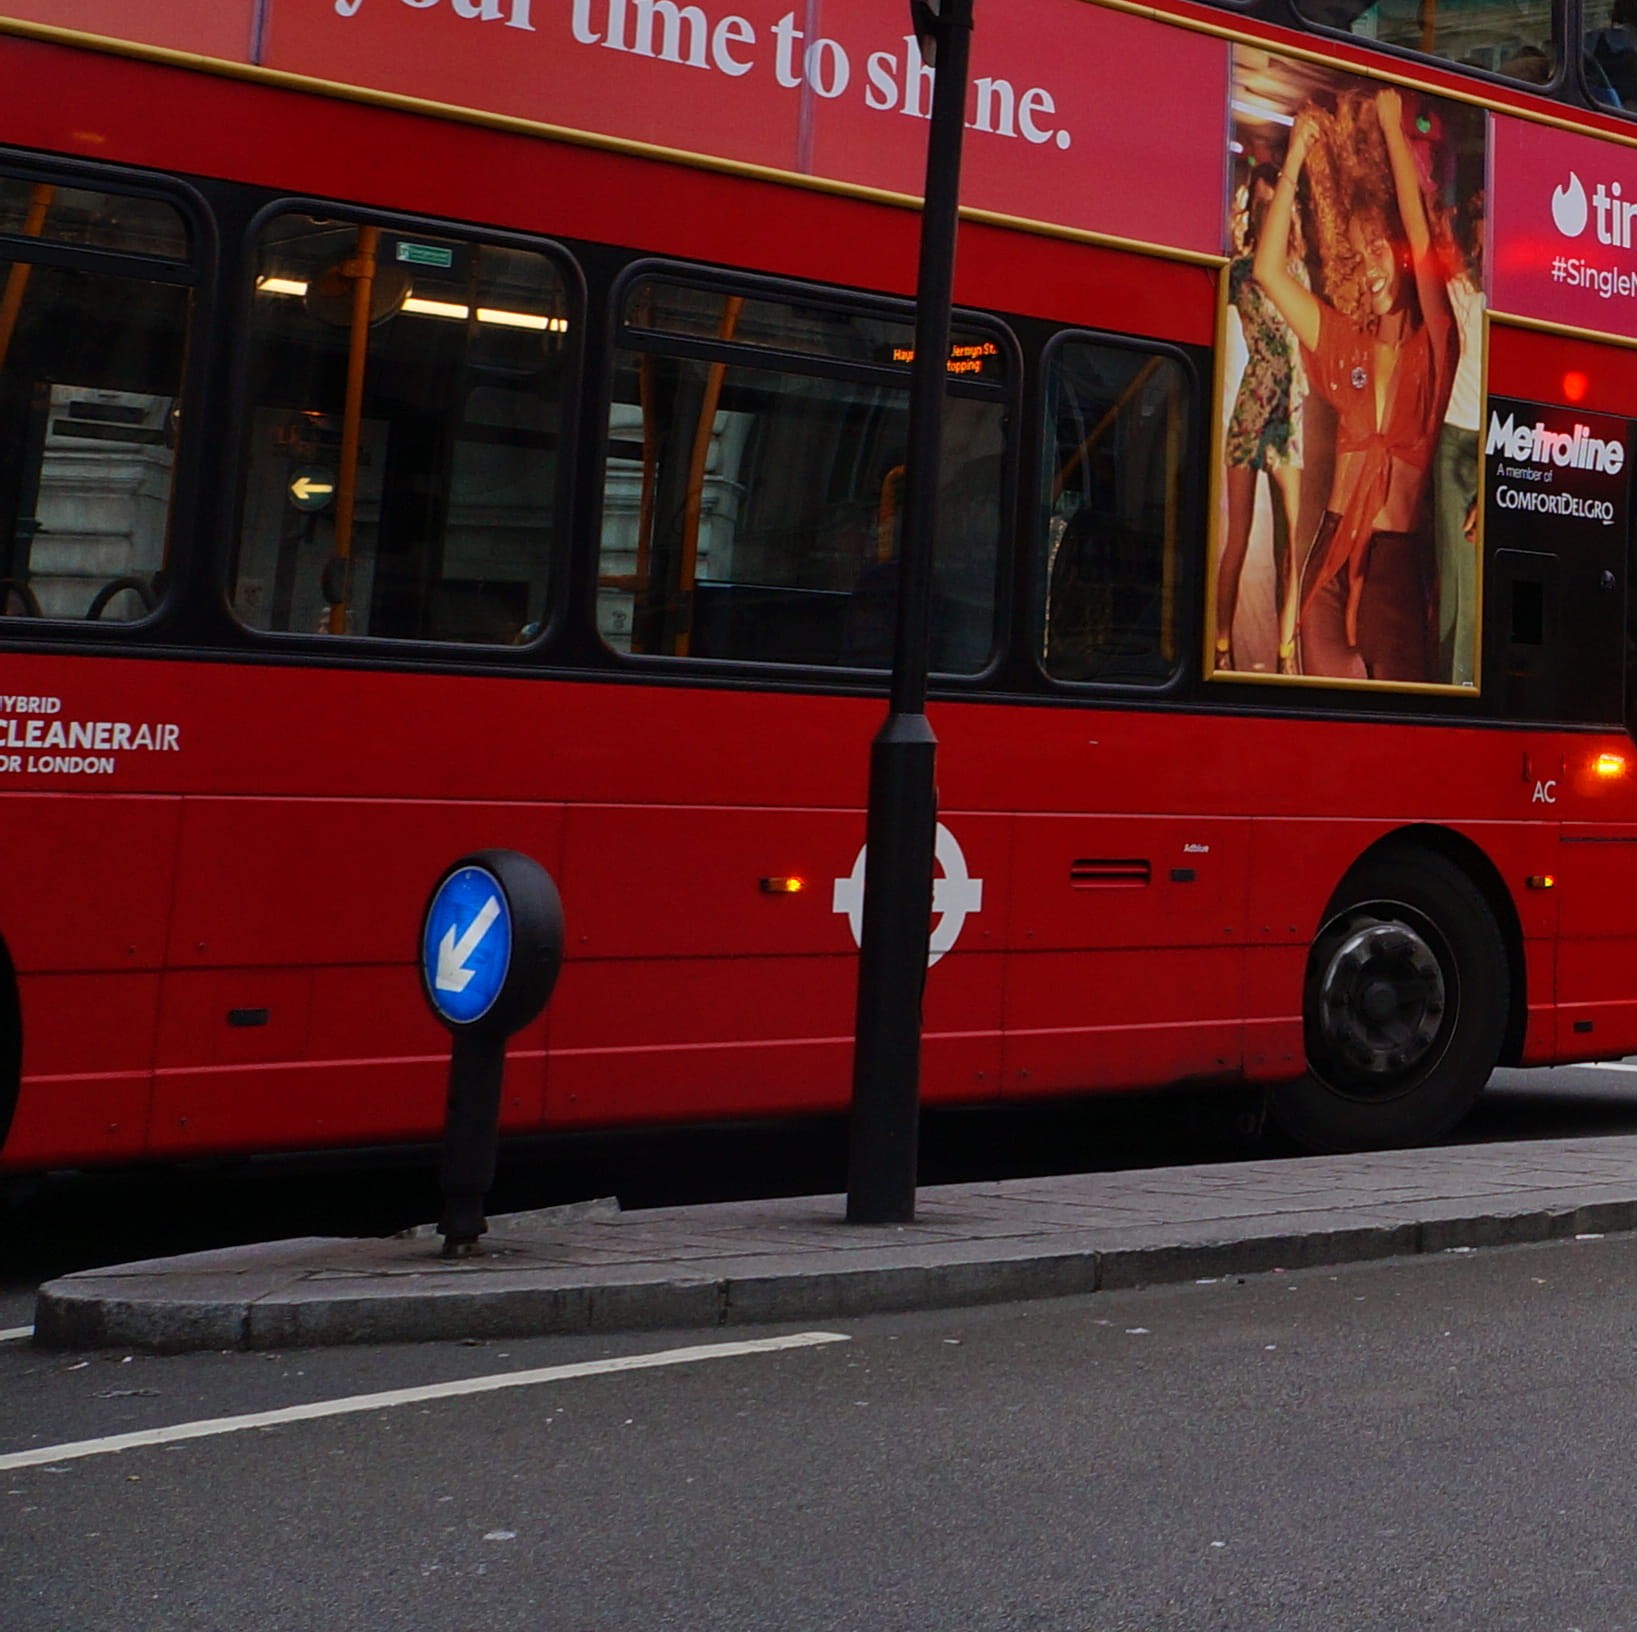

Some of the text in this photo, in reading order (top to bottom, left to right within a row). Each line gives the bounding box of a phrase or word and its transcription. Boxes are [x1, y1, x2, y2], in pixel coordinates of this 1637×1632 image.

[772, 11, 850, 100] to
[865, 34, 1071, 150] shne.
[1485, 410, 1625, 476] Metroline
[1496, 462, 1553, 482] A member of
[0, 695, 61, 714] YBRID
[27, 755, 116, 774] LONDON
[1532, 780, 1556, 804] AC
